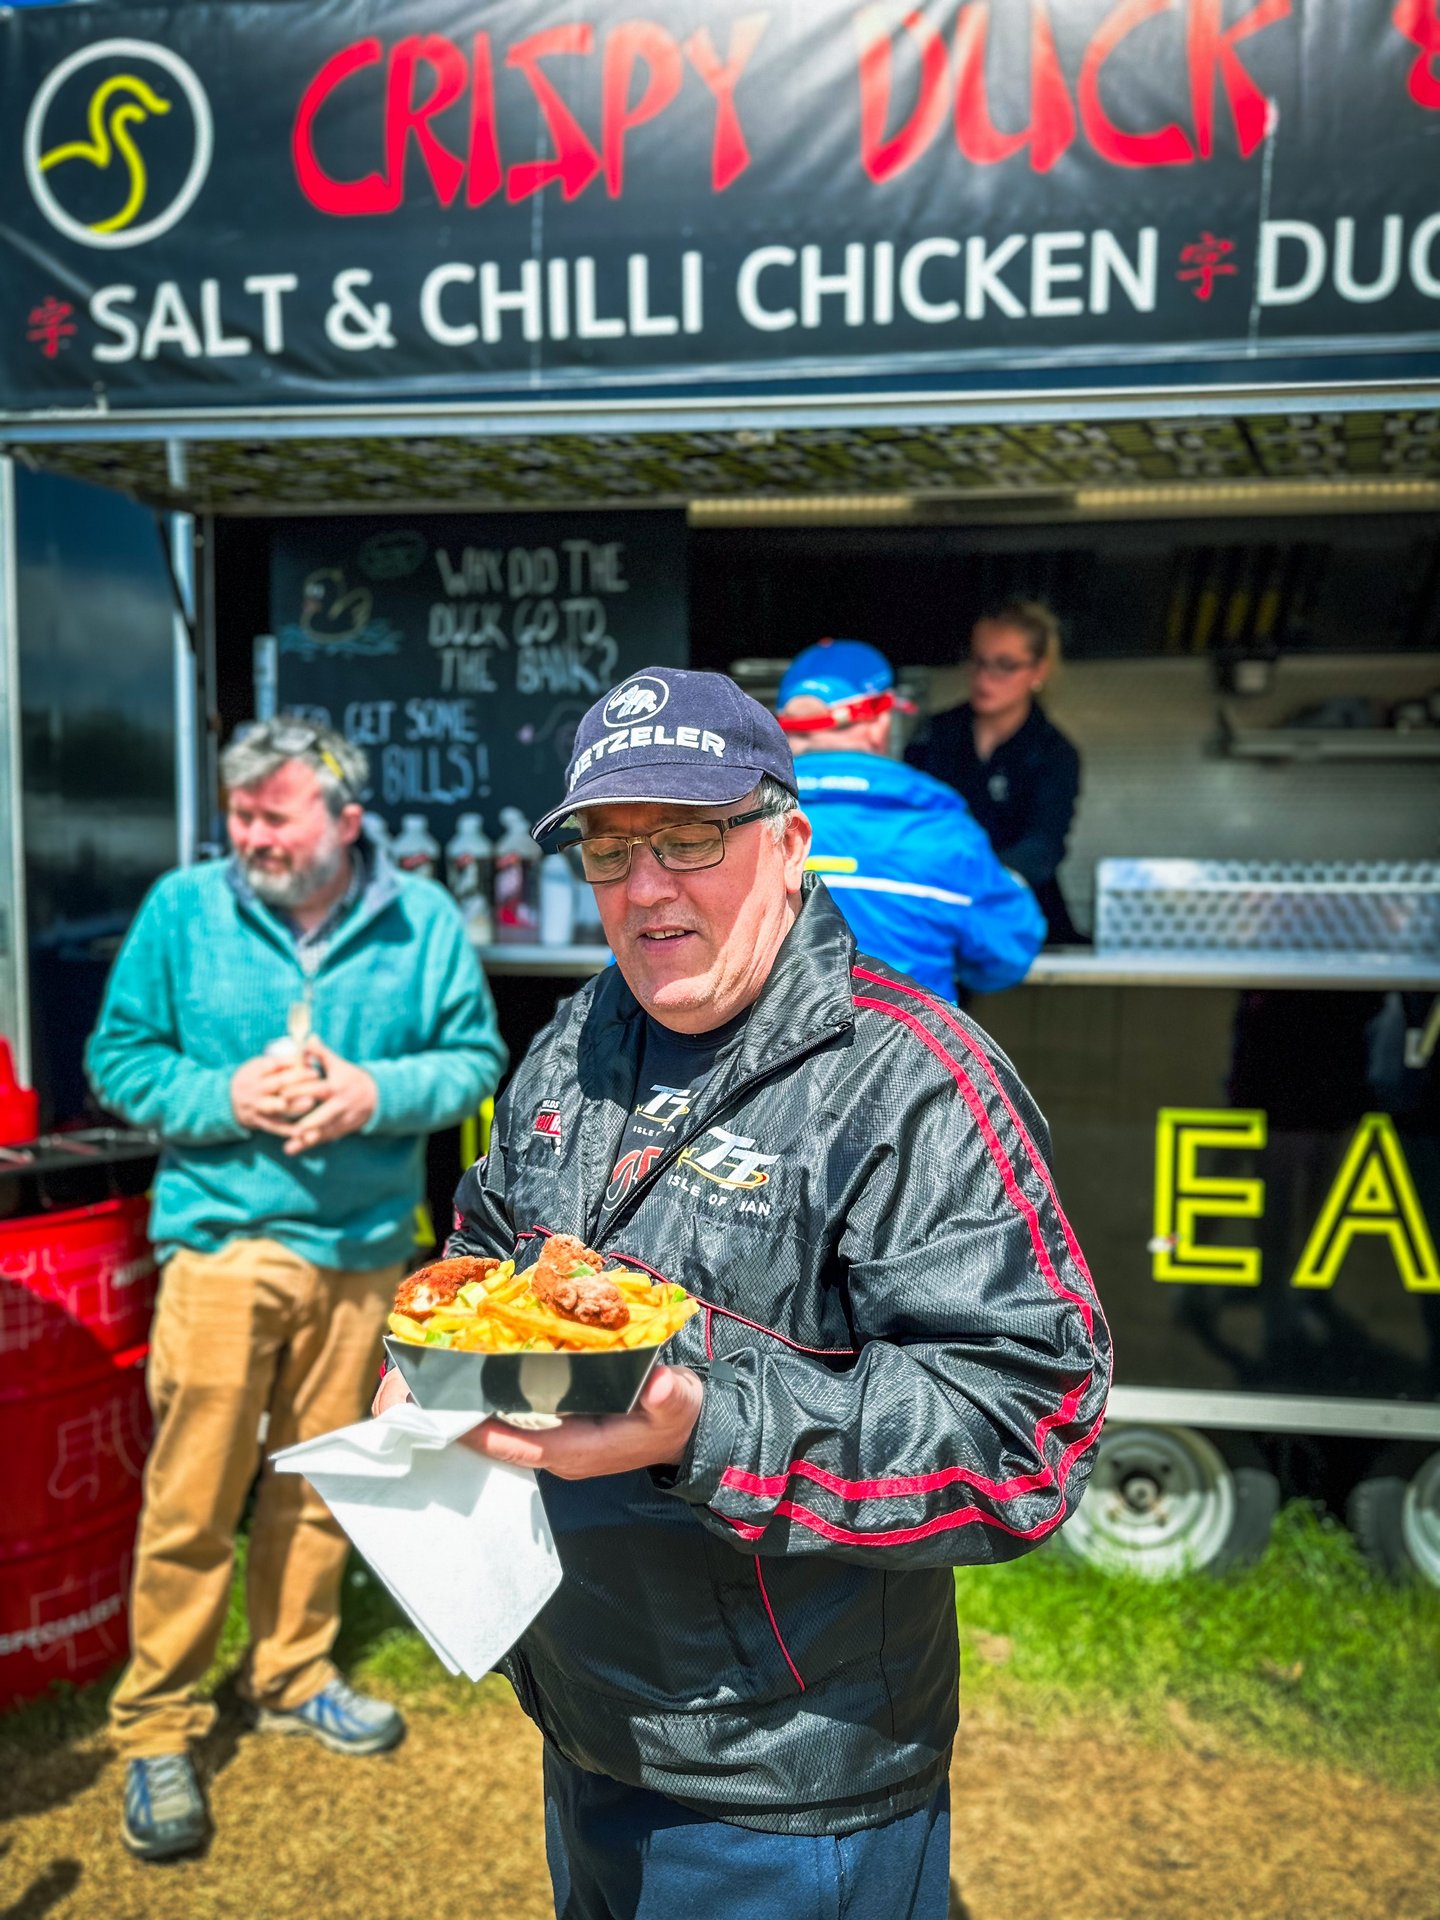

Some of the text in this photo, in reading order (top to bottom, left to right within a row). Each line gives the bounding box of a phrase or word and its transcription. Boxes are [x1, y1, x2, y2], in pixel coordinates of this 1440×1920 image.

[292, 10, 769, 215] CRISPY
[852, 0, 1292, 184] DUCK
[91, 227, 1158, 363] SALT & CHILLI CHICKEN
[561, 540, 629, 593] THE
[428, 601, 509, 649] DUCK
[513, 600, 559, 647] GO
[440, 647, 498, 693] THE
[405, 697, 478, 743] SOME
[632, 1125, 655, 1137] ISLE
[667, 1174, 701, 1197] ISLE
[709, 1193, 728, 1206] OF
